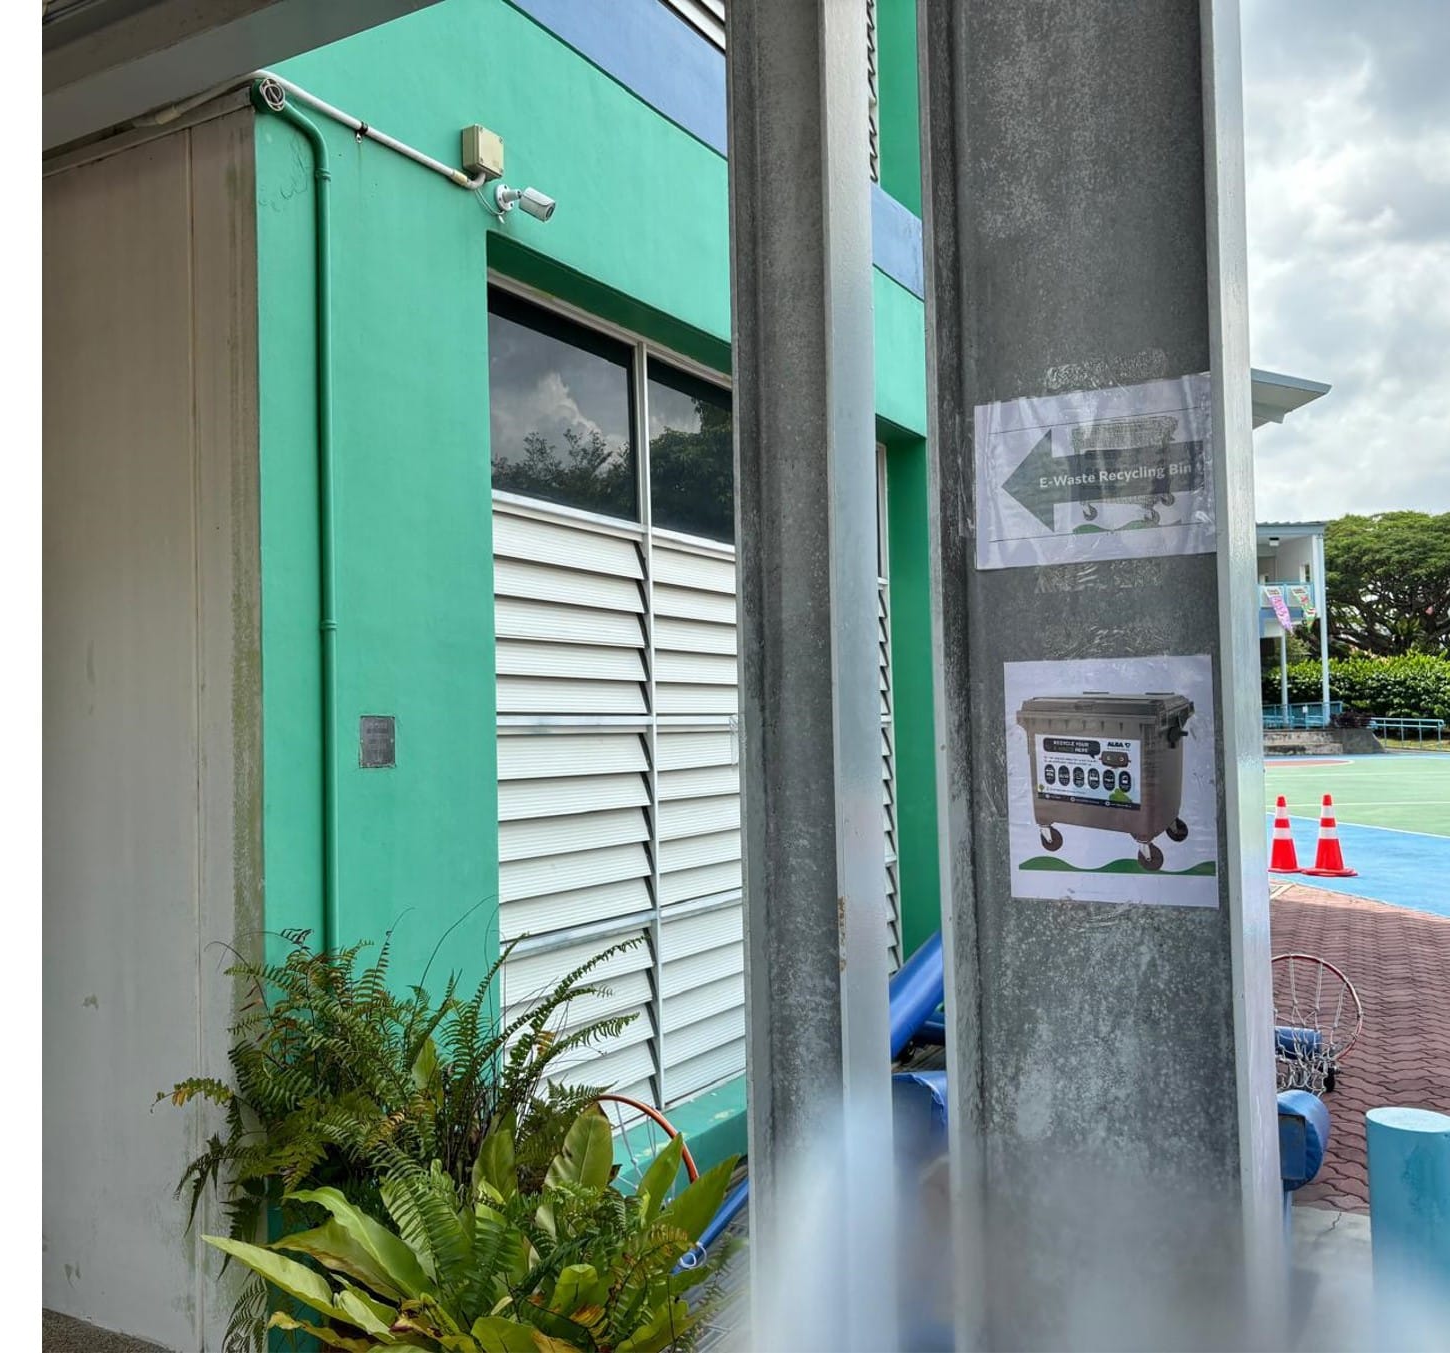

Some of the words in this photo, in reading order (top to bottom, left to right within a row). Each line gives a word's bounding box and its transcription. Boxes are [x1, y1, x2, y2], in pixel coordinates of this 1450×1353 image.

[1039, 473, 1096, 489] E-Waste
[1099, 466, 1166, 483] Recycling
[1169, 463, 1192, 476] Bin
